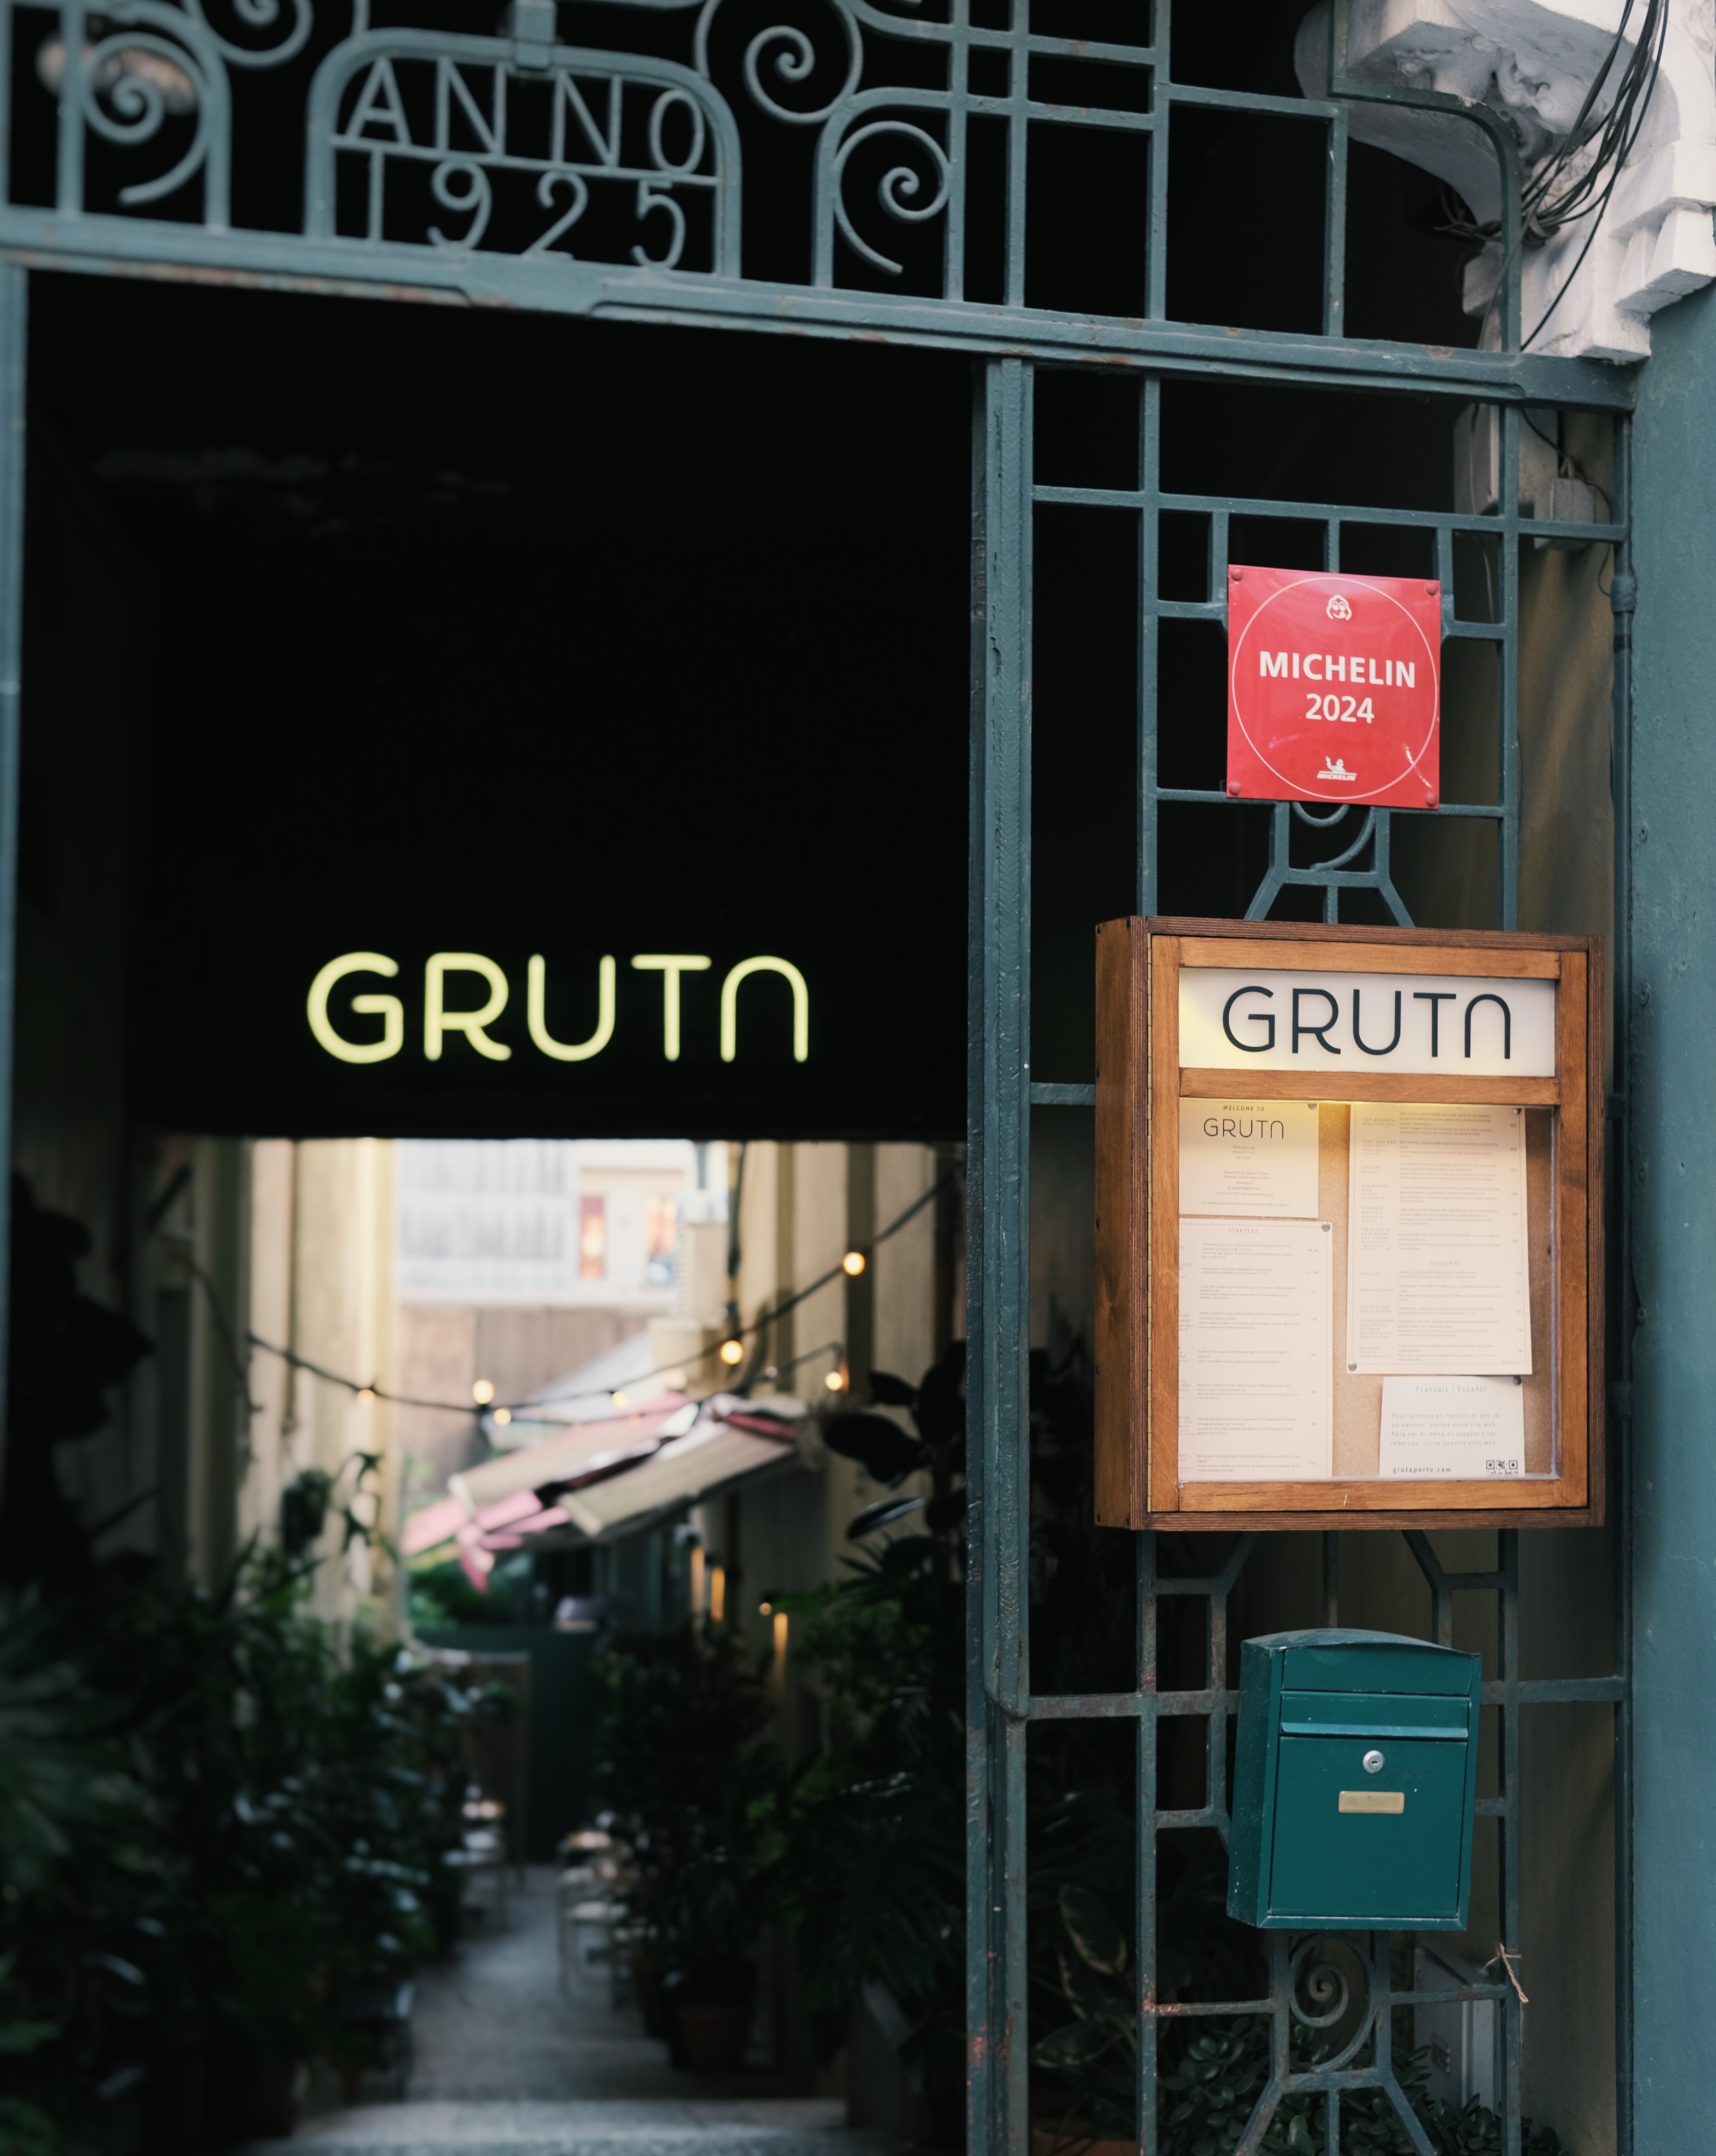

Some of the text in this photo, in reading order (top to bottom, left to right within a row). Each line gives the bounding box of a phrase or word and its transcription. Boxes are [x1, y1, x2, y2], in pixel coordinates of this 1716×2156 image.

[342, 57, 705, 174] ANNO
[369, 148, 686, 270] 1925
[1259, 651, 1415, 688] MICHELIN
[1305, 693, 1375, 724] 2024
[1416, 1386, 1449, 1394] Français
